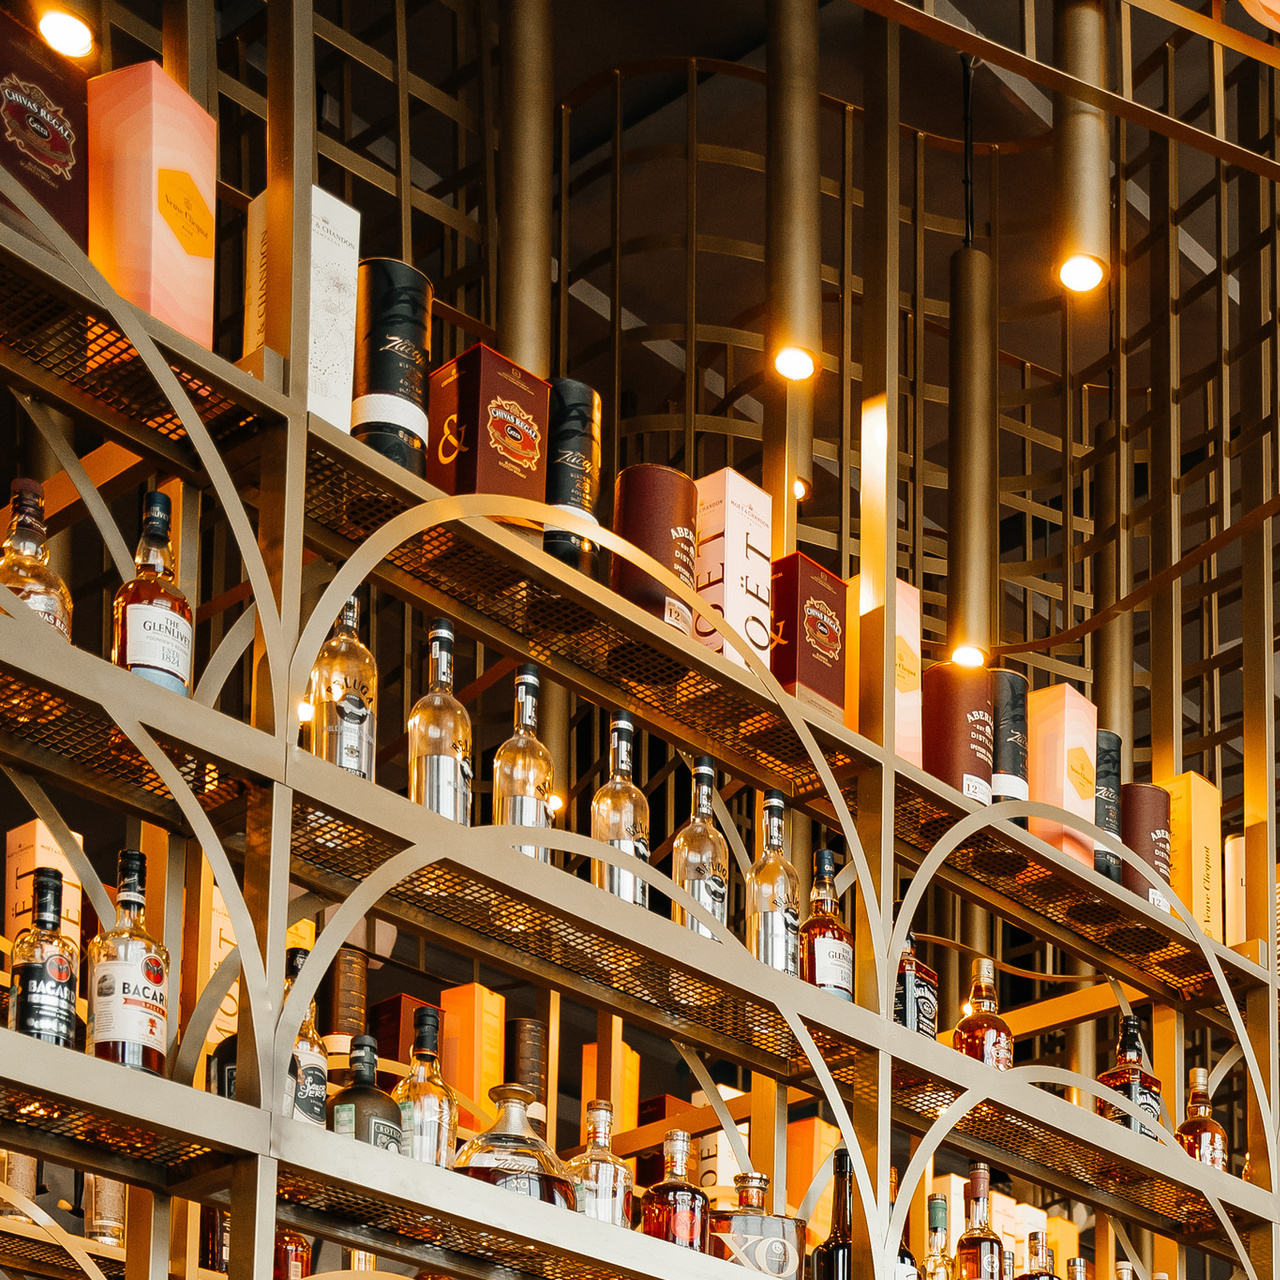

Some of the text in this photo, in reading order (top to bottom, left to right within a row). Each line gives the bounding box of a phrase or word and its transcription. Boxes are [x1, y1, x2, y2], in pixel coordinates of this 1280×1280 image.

[4, 88, 72, 141] CHIVAS REGAL
[321, 225, 355, 250] CHANDON
[257, 229, 268, 325] CHANDON
[490, 407, 539, 441] CHIVAS REGAL
[438, 413, 470, 465] &
[164, 617, 180, 630] THE
[667, 607, 681, 622] 12
[143, 620, 191, 649] GLENLIVET
[161, 653, 180, 668] 1824
[966, 783, 978, 794] 12
[1202, 845, 1216, 924] Veuve Clicquot
[122, 982, 167, 1006] BACAR
[510, 1178, 529, 1189] XO
[709, 1231, 800, 1279] XO
